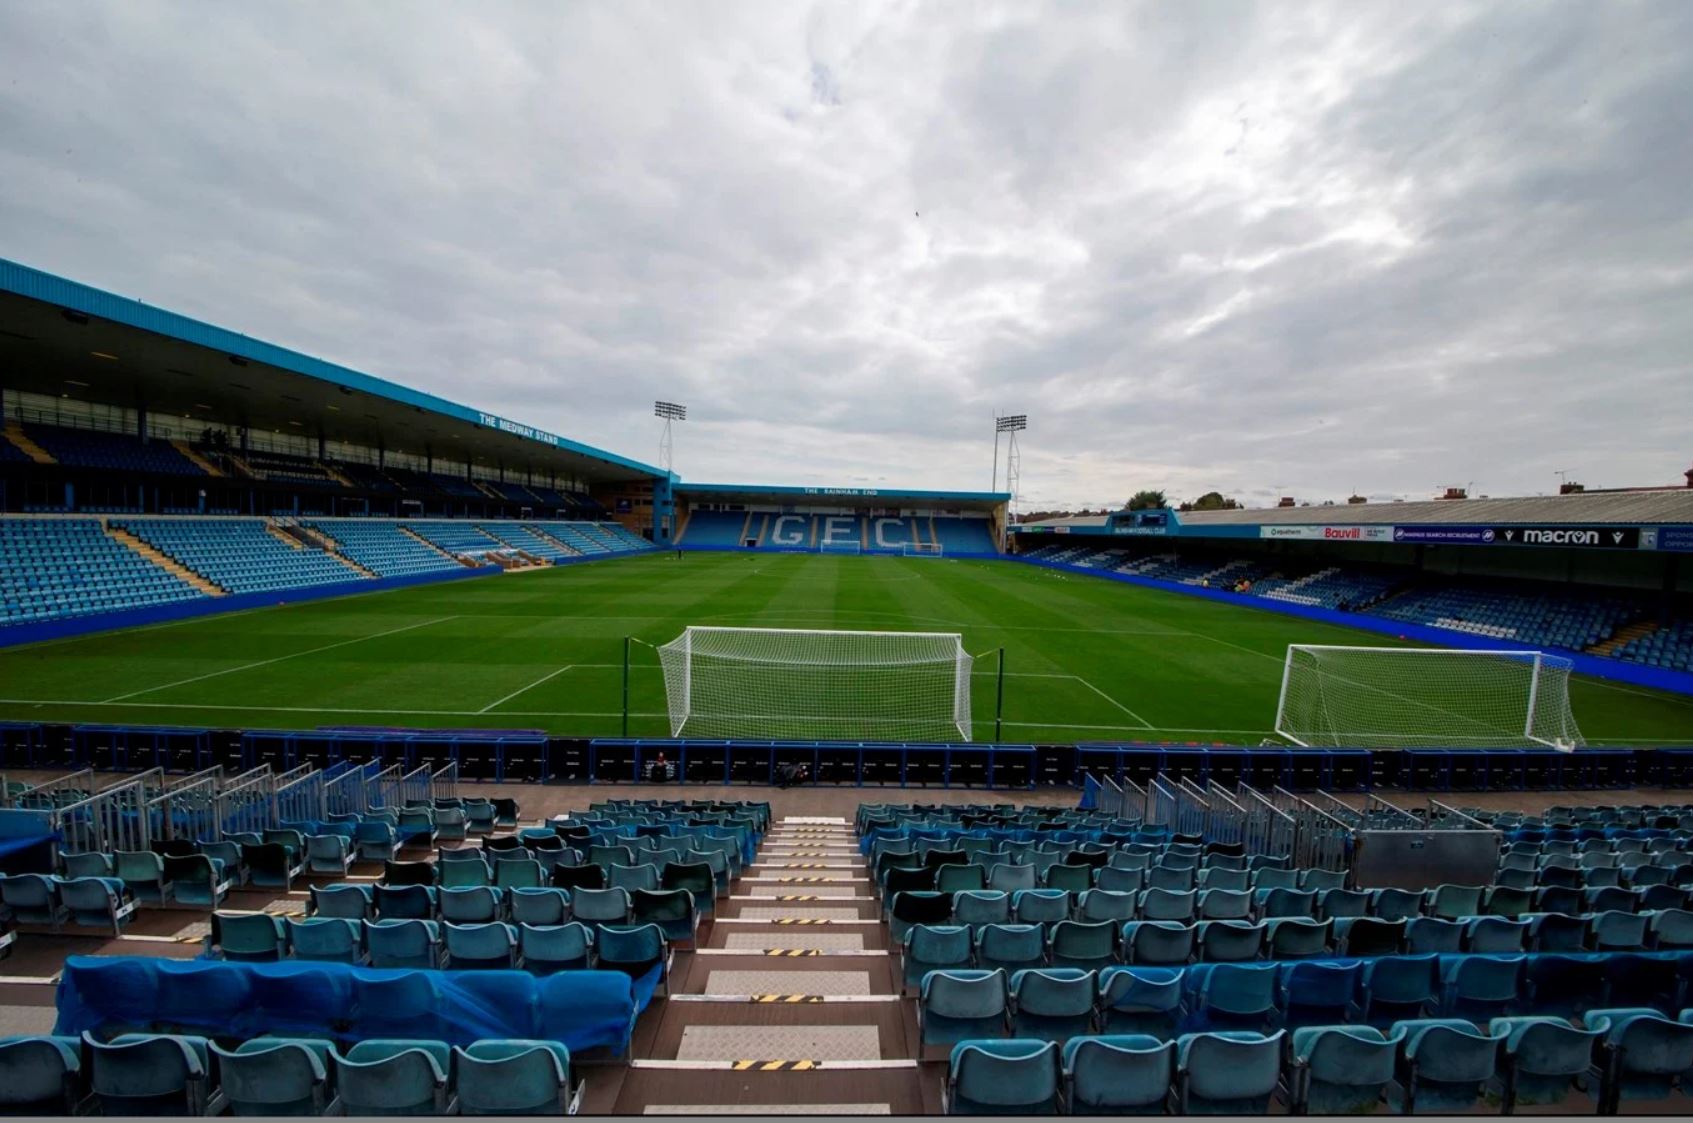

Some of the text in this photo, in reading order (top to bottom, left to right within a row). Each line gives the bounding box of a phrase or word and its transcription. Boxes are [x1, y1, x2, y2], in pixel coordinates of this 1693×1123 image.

[480, 413, 559, 445] THE MEDWAY STAND
[862, 488, 878, 496] END
[772, 515, 905, 547] GFC
[1325, 528, 1361, 539] Bauvill
[1523, 529, 1600, 544] macron
